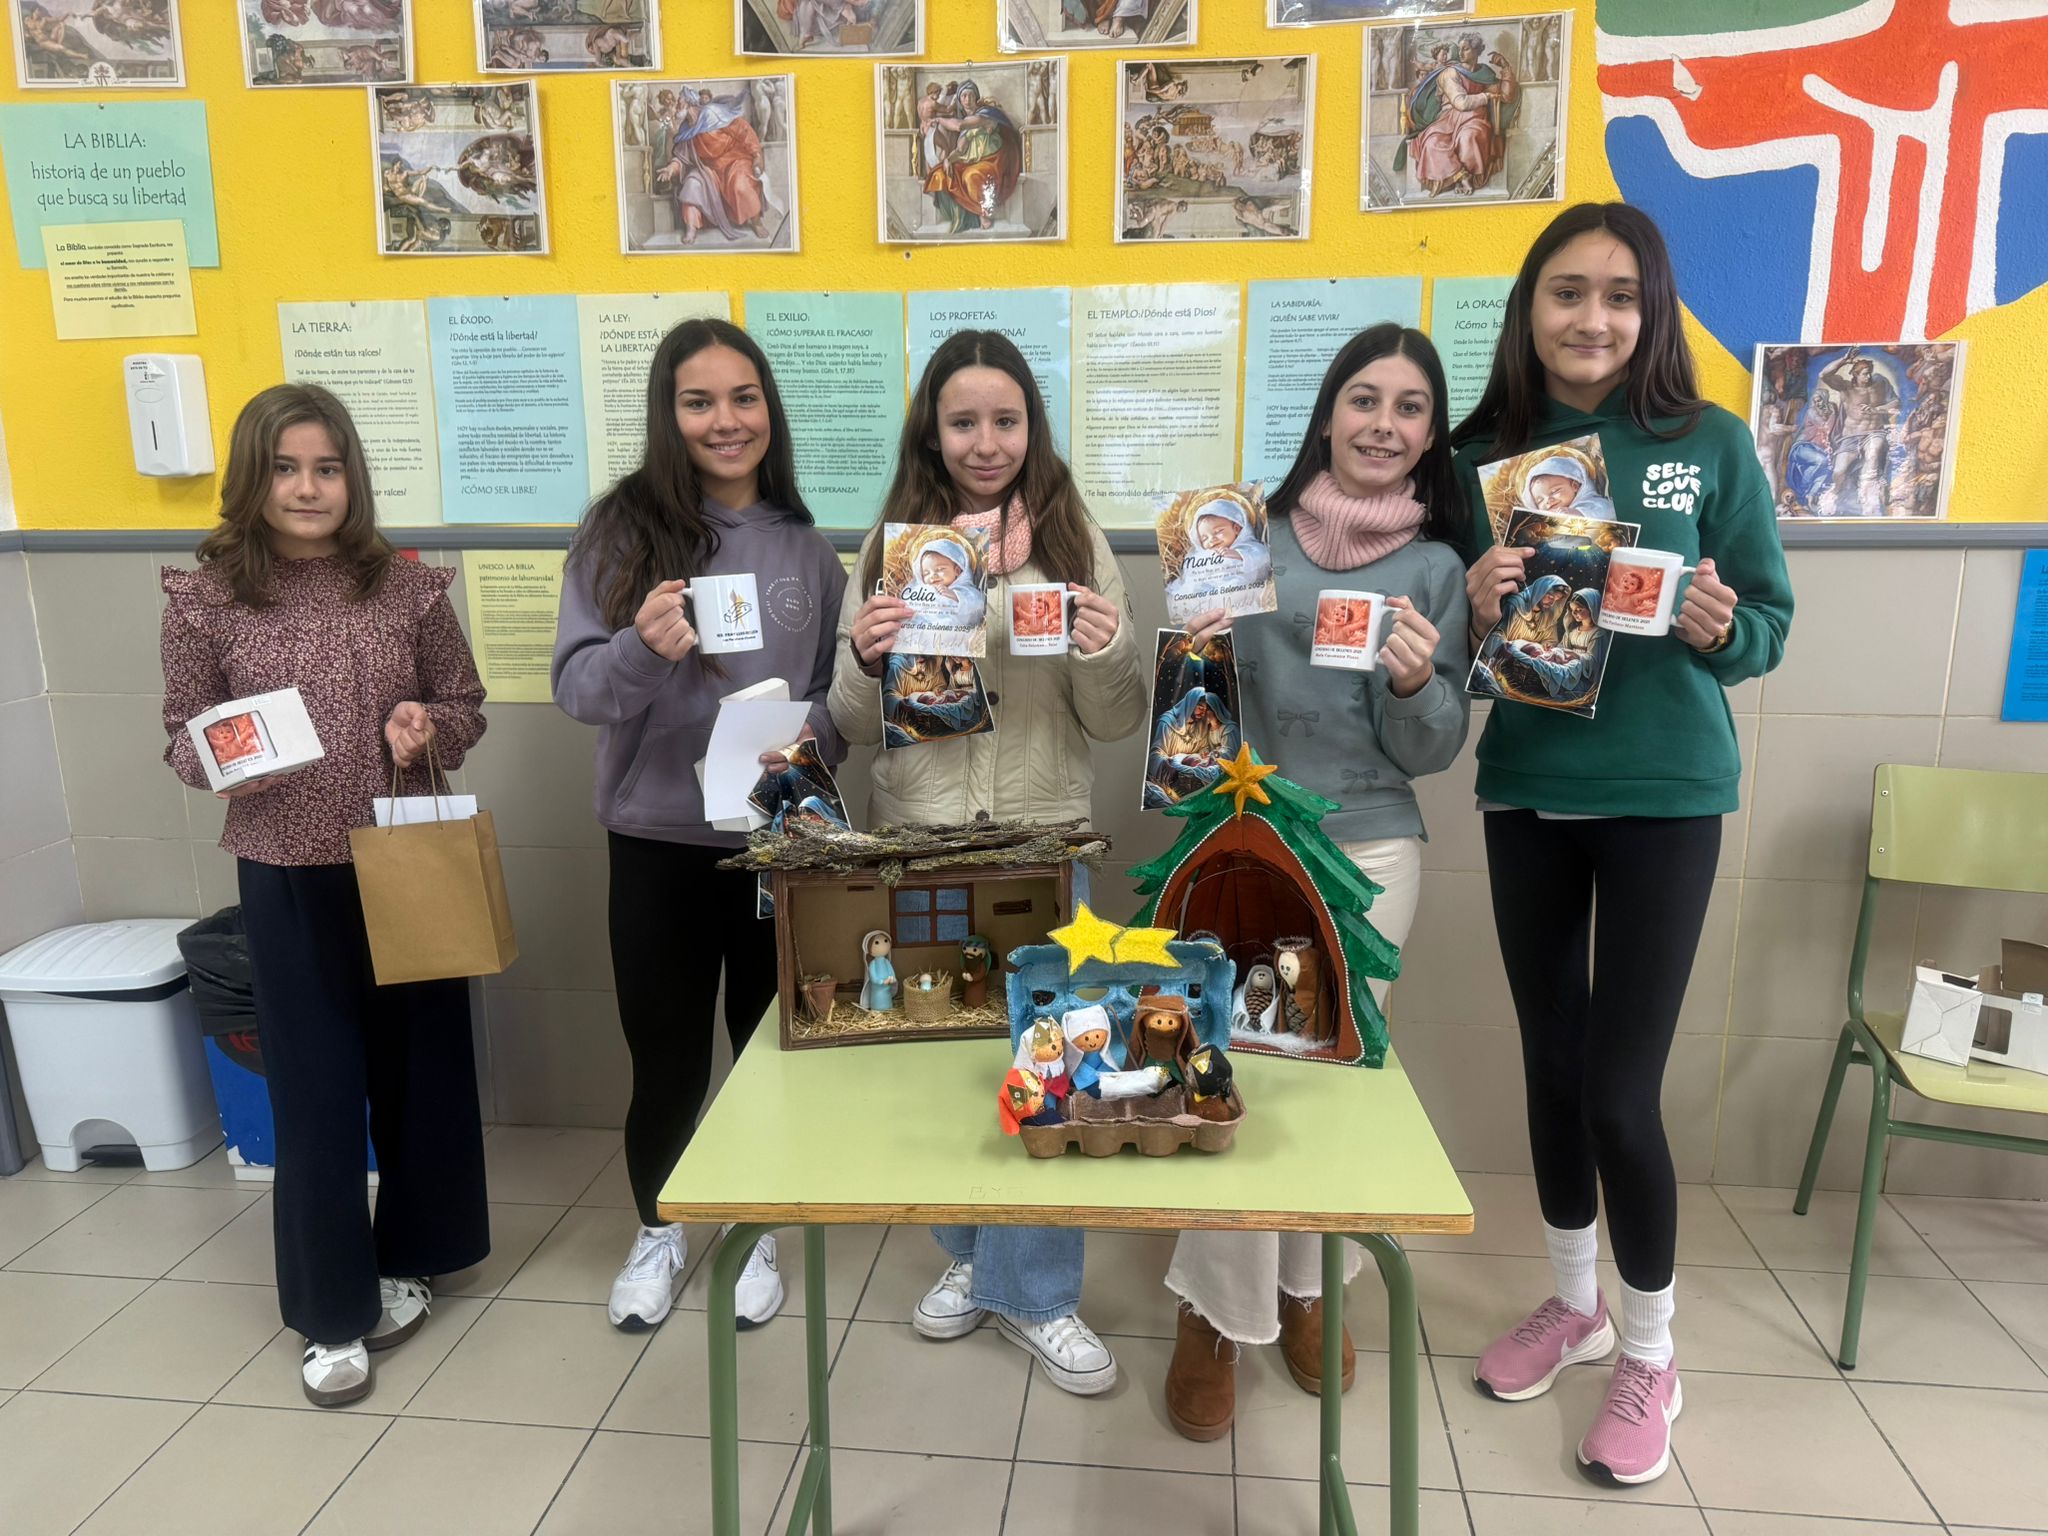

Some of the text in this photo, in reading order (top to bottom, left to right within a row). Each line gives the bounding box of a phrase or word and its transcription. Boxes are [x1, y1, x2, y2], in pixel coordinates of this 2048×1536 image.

[65, 133, 146, 149] LA BIBLIA:
[31, 160, 186, 184] historia de un pueblo
[37, 186, 187, 211] que busca su libertad
[1457, 299, 1506, 309] LA ORACI
[599, 314, 611, 323] LA
[767, 313, 776, 321] EL
[930, 311, 998, 321] LOS PROFETAS:
[1088, 310, 1098, 319] EL
[1175, 308, 1191, 317] está
[1194, 307, 1217, 317] Dios?
[449, 315, 493, 325] EL ÉXODO:
[292, 322, 352, 333] LA TIERRA:
[450, 332, 479, 342] ¿Dónde
[480, 332, 495, 341] está
[506, 330, 538, 340] libertad?
[600, 329, 636, 340] ¿DÓNDE
[638, 328, 659, 339] ESTÁ
[295, 349, 322, 358] ¿Dónde
[323, 350, 343, 358] están
[358, 348, 382, 357] raíces?
[601, 345, 613, 353] LA
[1646, 462, 1701, 481] SELF
[1264, 475, 1283, 483] ¿CÓM
[495, 486, 510, 494] SER
[512, 486, 538, 494] LIBRE?
[1643, 475, 1701, 497] LOVE
[384, 488, 407, 496] raíces?
[1109, 489, 1141, 497] escondido
[1643, 493, 1695, 515] CLUB
[1181, 553, 1224, 570] María
[902, 588, 936, 601] Celia
[1174, 591, 1207, 601] Concurso
[1209, 587, 1218, 596] de
[1220, 584, 1247, 594] Belenes
